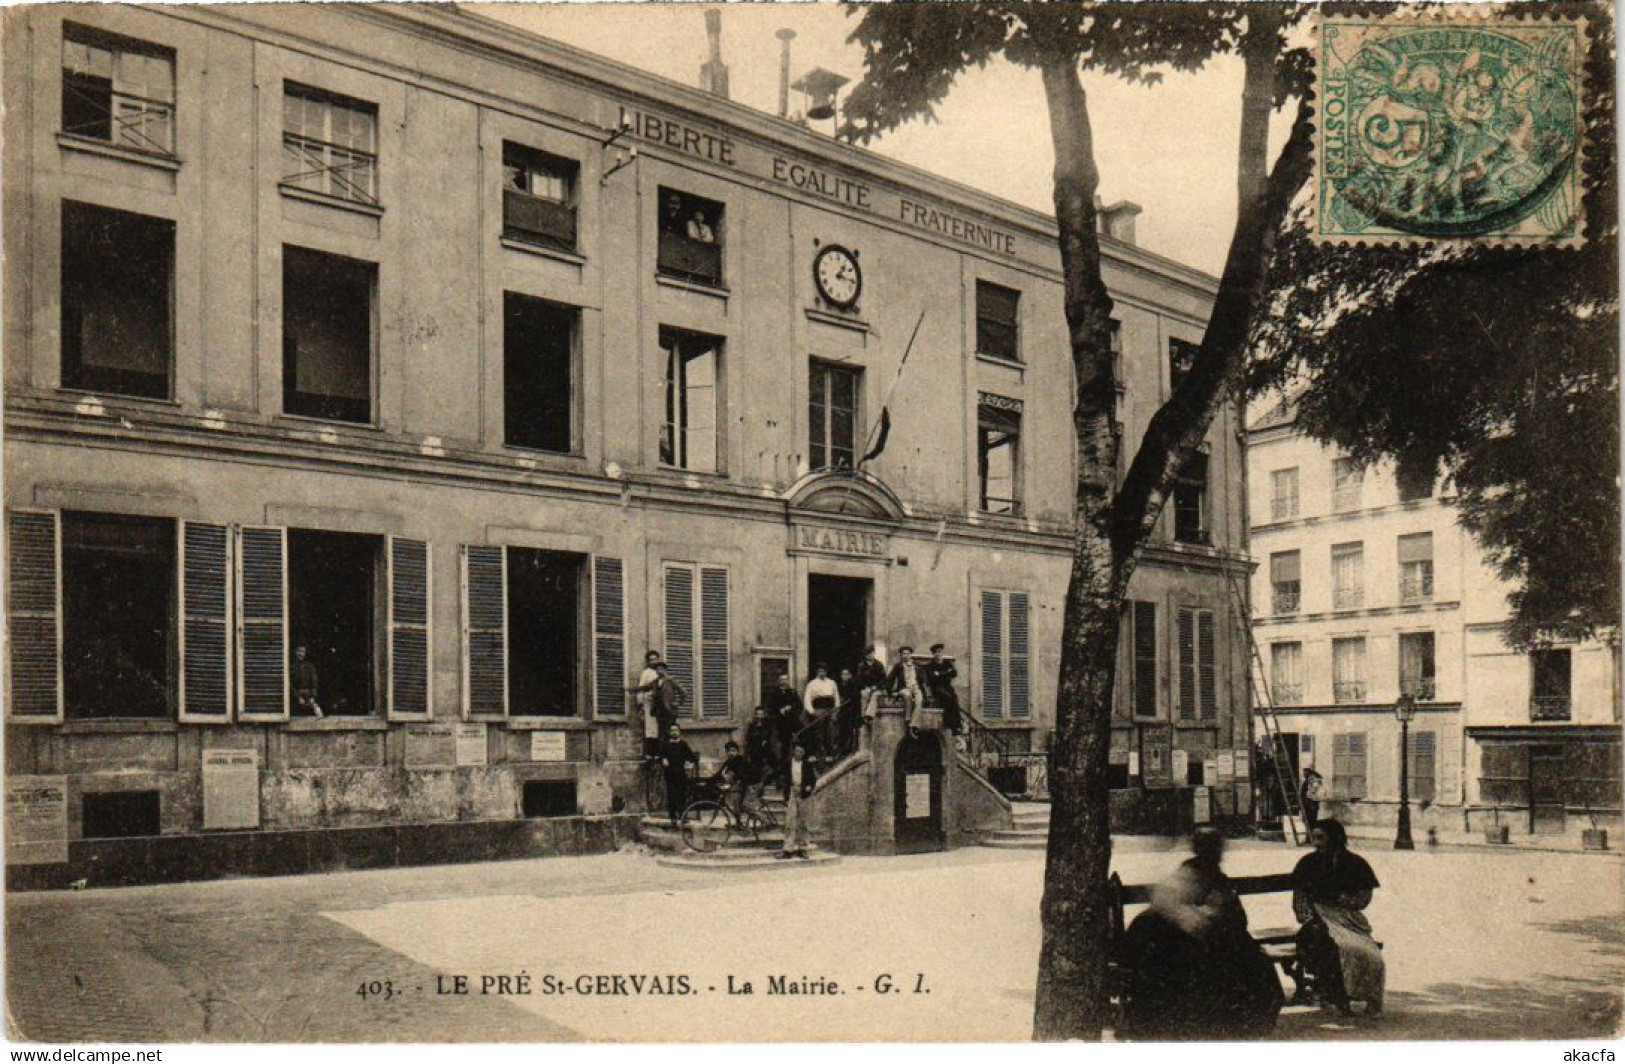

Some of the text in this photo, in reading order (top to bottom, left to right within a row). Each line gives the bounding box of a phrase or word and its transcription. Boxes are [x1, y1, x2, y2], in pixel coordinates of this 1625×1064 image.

[1326, 81, 1345, 175] POSTES
[1364, 113, 1426, 157] 5
[801, 526, 884, 555] MAIRIE
